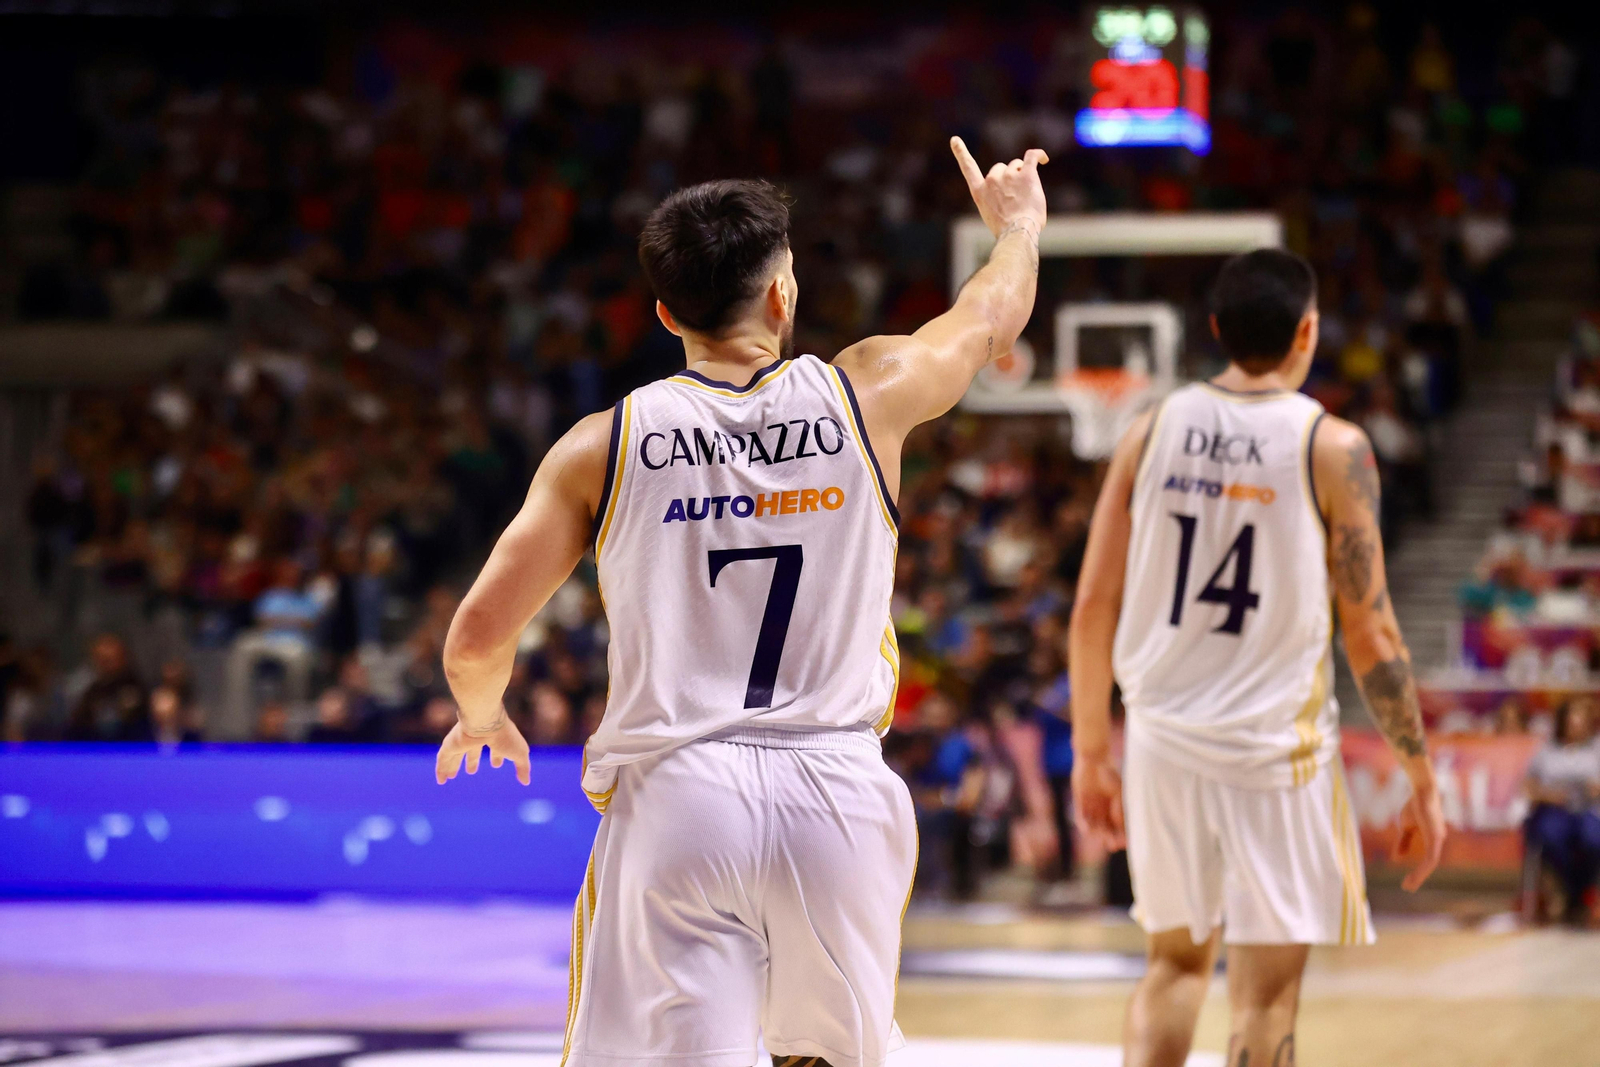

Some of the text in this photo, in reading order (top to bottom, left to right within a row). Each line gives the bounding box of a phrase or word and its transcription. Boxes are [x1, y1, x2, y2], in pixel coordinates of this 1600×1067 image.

[640, 416, 845, 471] CAMPAZZO
[1184, 427, 1267, 465] DECK
[662, 486, 845, 523] AUTOHERO
[1168, 512, 1260, 636] 14
[707, 544, 804, 710] 7
